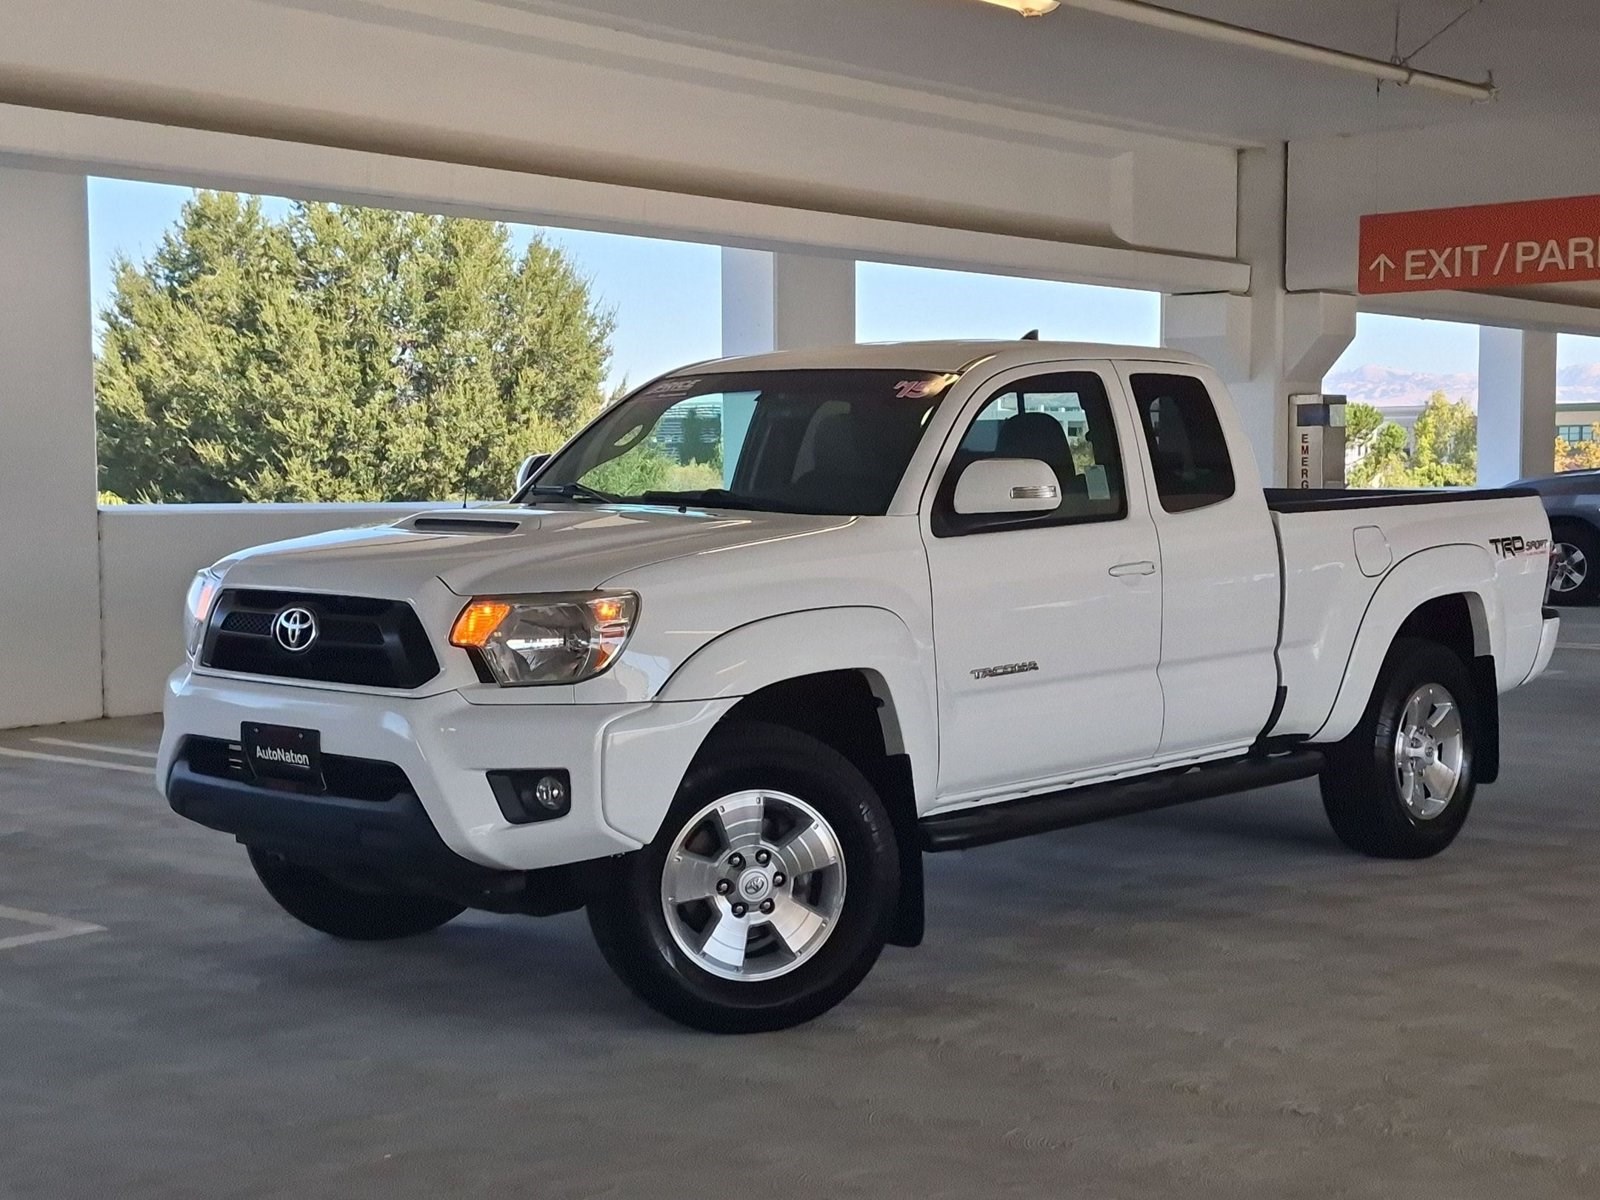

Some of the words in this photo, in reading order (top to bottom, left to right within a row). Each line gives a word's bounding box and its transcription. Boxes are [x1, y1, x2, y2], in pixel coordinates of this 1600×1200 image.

[1404, 244, 1488, 281] EXIT
[1515, 236, 1600, 274] PAR
[1489, 536, 1524, 559] TRD
[970, 661, 1039, 679] TACOMA
[256, 745, 310, 766] AutoNation
